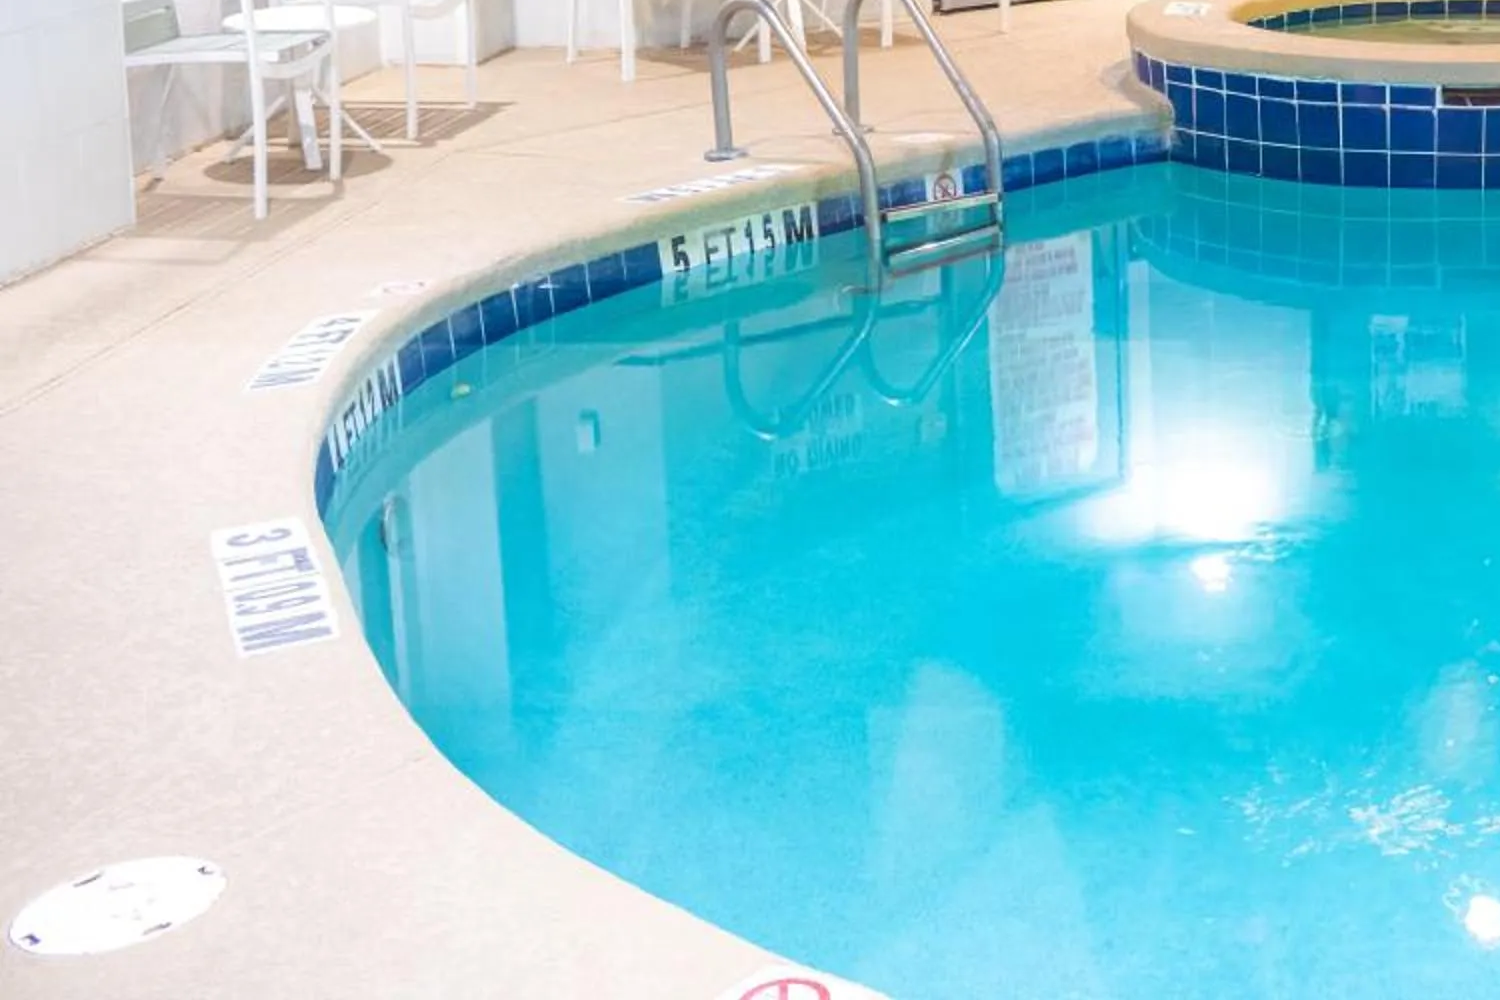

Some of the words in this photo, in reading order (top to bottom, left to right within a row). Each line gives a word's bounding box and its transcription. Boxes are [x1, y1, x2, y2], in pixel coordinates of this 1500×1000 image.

[671, 234, 691, 272] 5
[703, 226, 736, 264] FT
[782, 206, 814, 244] M
[226, 527, 292, 547] 3
[224, 545, 315, 582] FT
[237, 611, 333, 652] M
